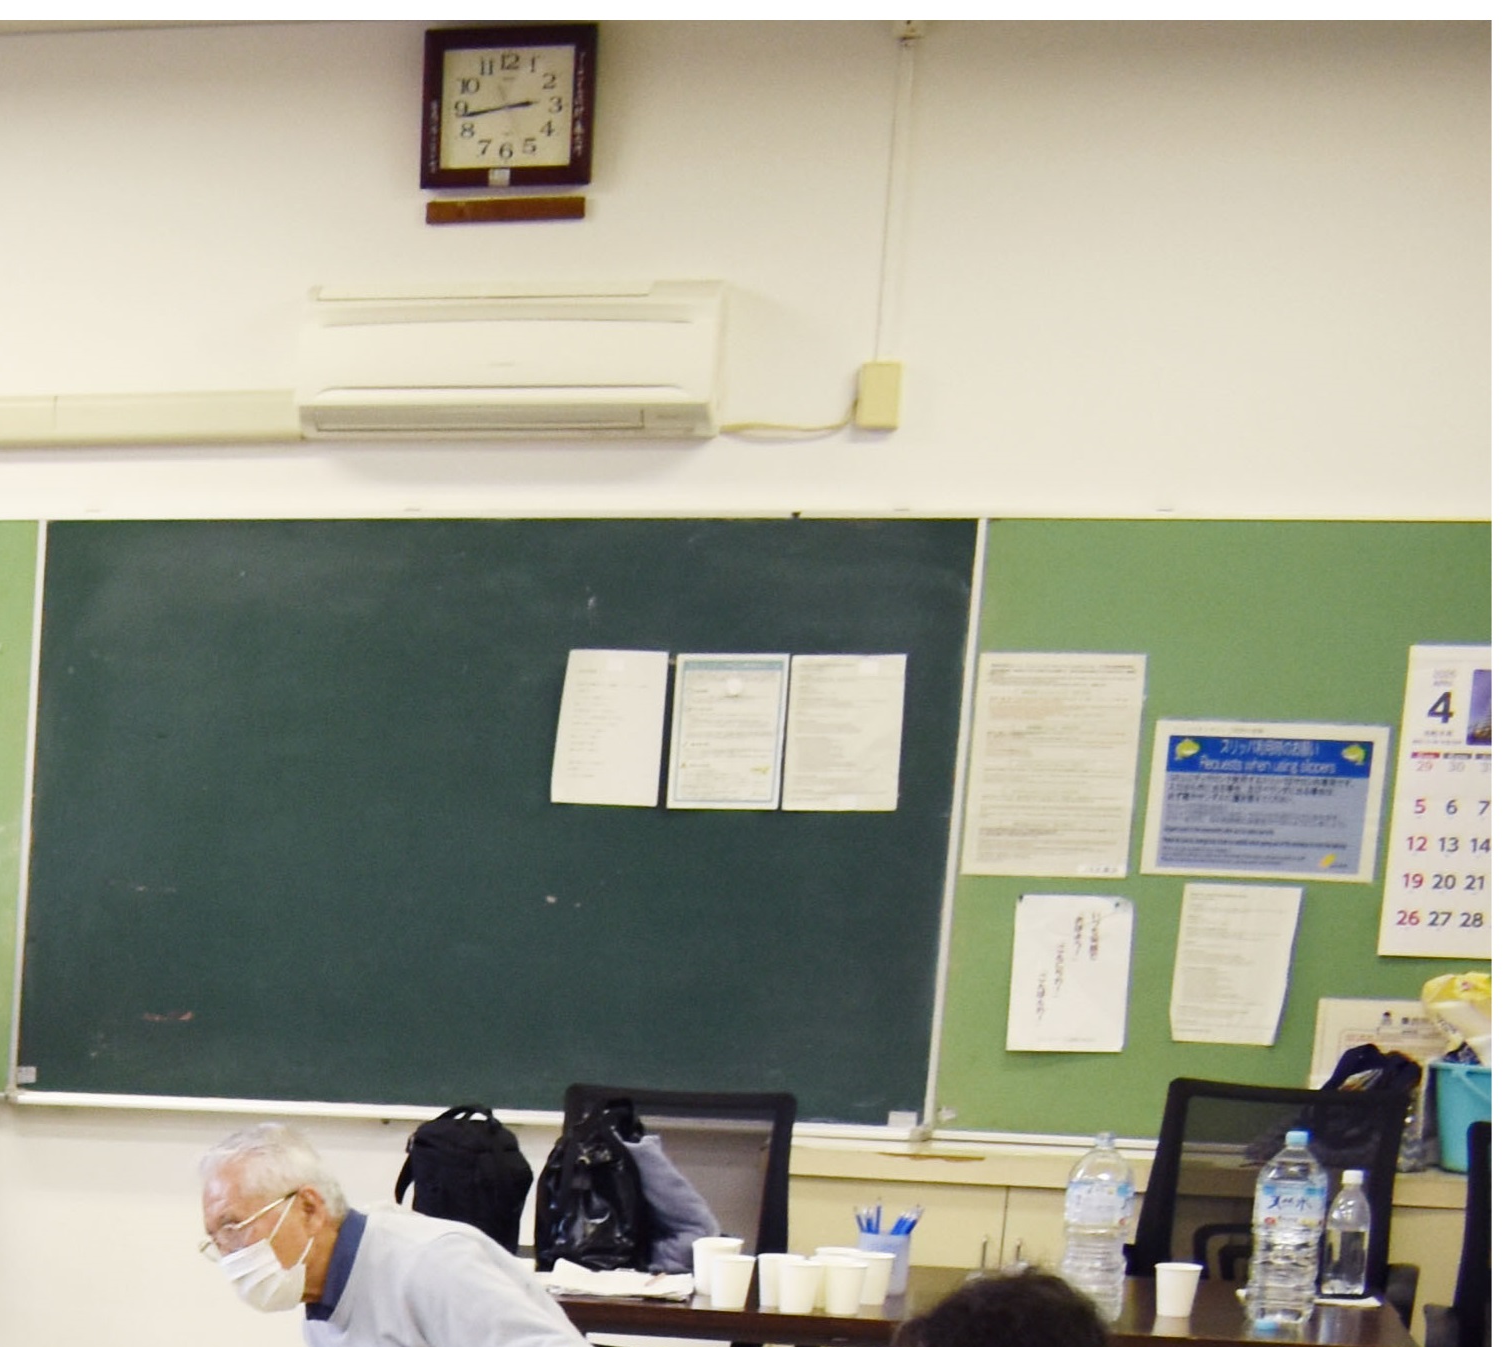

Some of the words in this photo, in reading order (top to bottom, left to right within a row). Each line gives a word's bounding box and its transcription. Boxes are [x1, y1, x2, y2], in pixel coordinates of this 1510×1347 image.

[479, 56, 494, 76] 11
[500, 52, 520, 71] 12
[529, 55, 540, 73] 1
[459, 77, 480, 94] 10
[542, 73, 557, 90] 2
[454, 100, 469, 118] 9
[548, 96, 563, 114] 3
[459, 122, 475, 139] 8
[540, 120, 555, 137] 4
[478, 138, 492, 156] 7
[498, 142, 514, 160] 6
[522, 137, 537, 155] 5
[1427, 691, 1454, 724] 4
[1414, 798, 1426, 815] 5
[1446, 799, 1458, 815] 6
[1478, 800, 1490, 816] 7
[1407, 836, 1427, 852] 12
[1438, 837, 1459, 853] 13
[1470, 837, 1491, 853] 14
[1403, 873, 1424, 889] 19
[1432, 873, 1456, 890] 20
[1463, 875, 1485, 890] 21
[1396, 910, 1420, 926] 26
[1427, 911, 1452, 927] 27
[1459, 912, 1484, 928] 28
